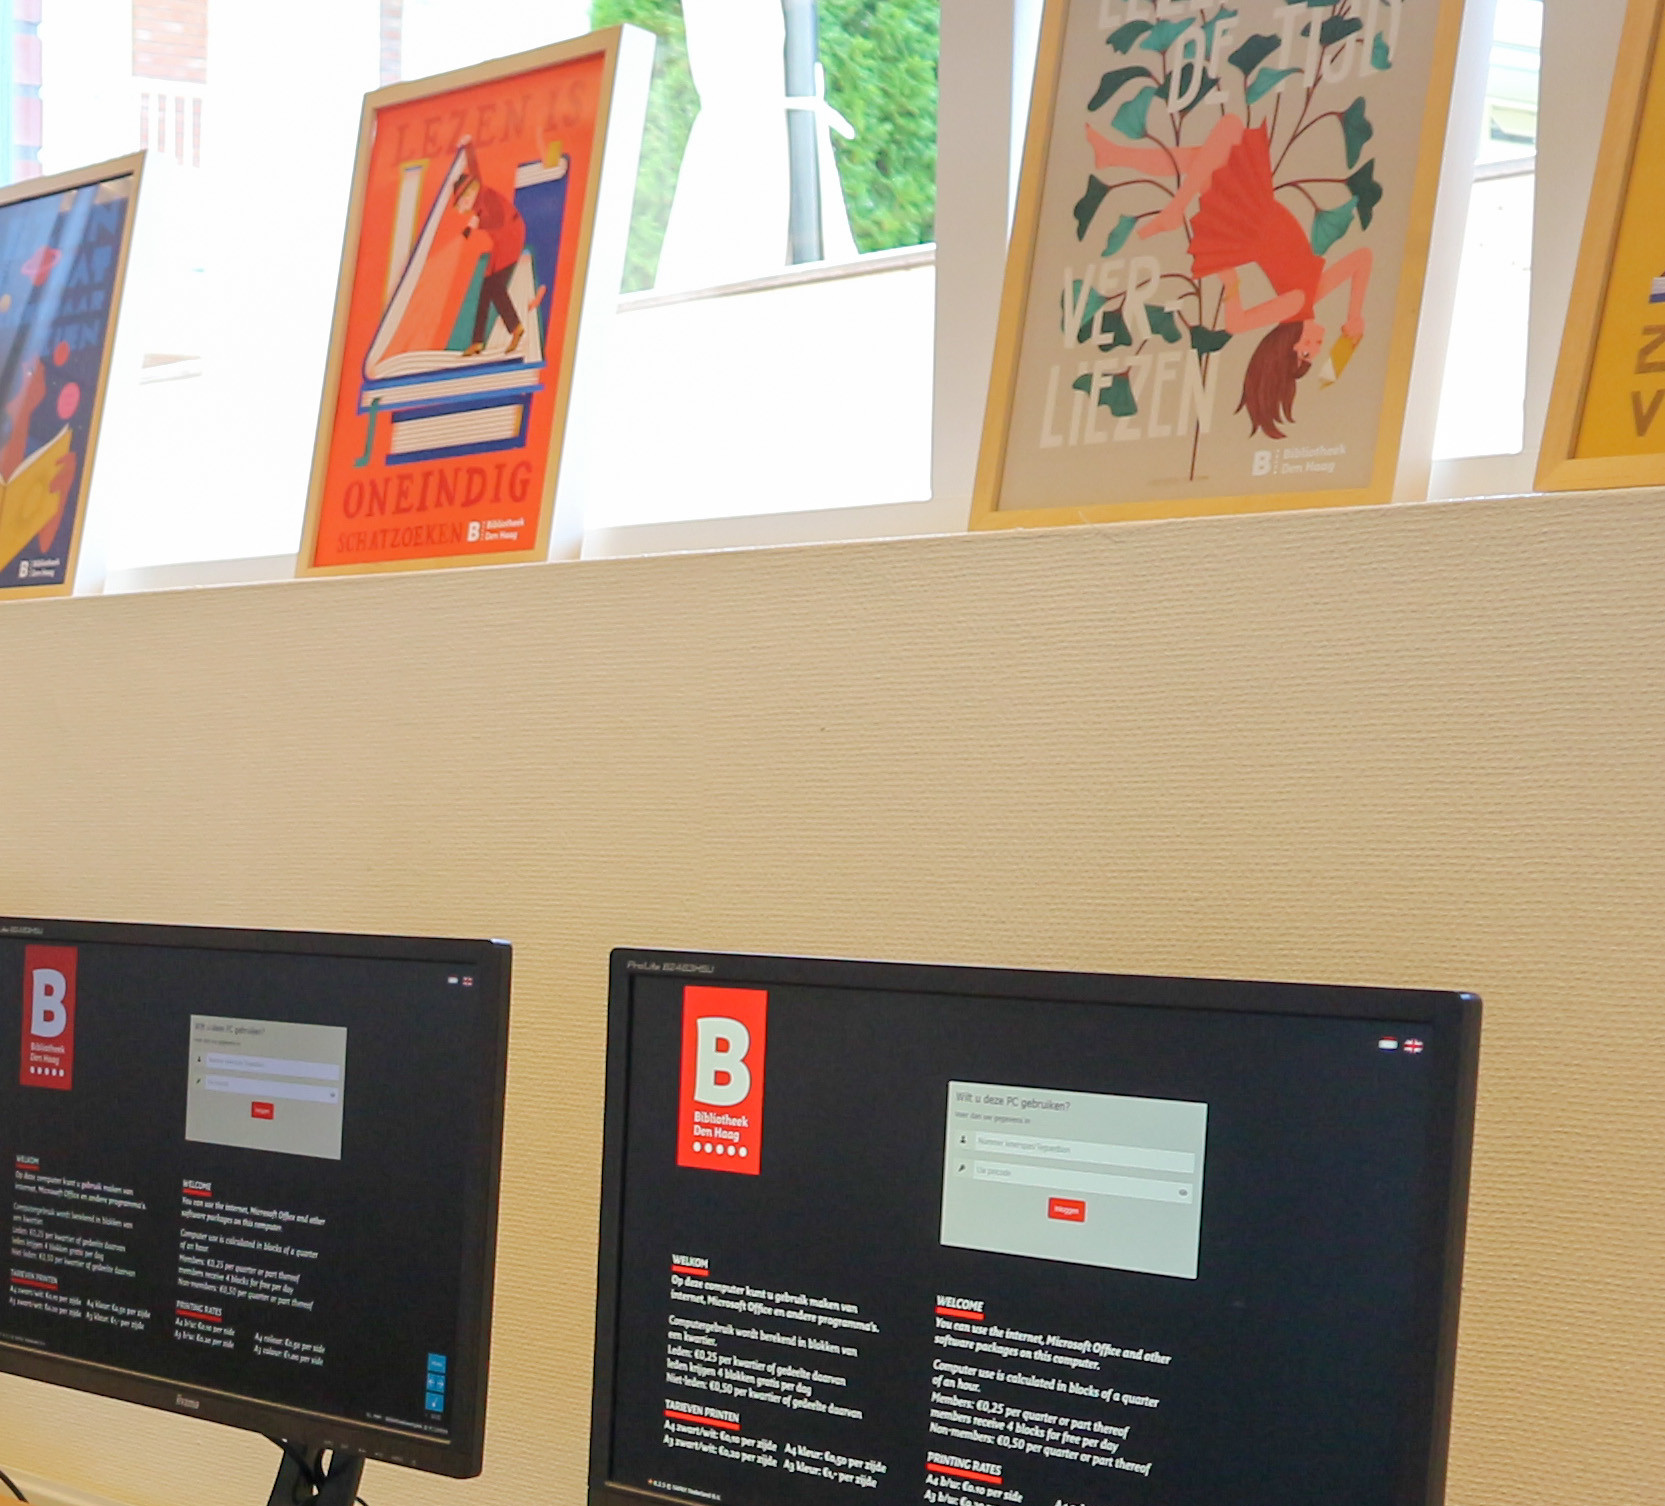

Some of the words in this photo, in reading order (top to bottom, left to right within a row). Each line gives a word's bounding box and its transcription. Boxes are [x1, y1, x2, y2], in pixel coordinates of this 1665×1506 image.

[395, 93, 529, 162] LEZEN
[543, 80, 585, 133] IS
[1039, 349, 1221, 449] LIEZEN
[1251, 450, 1274, 476] B
[1283, 444, 1346, 460] Bibliotheek
[1281, 462, 1303, 474] Den
[1305, 460, 1335, 474] Haag
[342, 460, 533, 519] ONEINDIG
[337, 522, 463, 554] SCHATZOEKEN
[467, 520, 481, 542] B
[30, 967, 67, 1038] B
[693, 1016, 752, 1107] B
[956, 1092, 973, 1104] Wilt
[975, 1095, 981, 1104] u
[983, 1094, 1005, 1106] deze
[1006, 1096, 1019, 1107] PC
[1021, 1098, 1071, 1112] gebruiken?
[693, 1124, 713, 1138] Den
[714, 1126, 740, 1142] Haag
[694, 1111, 749, 1128] Bibliotheek
[672, 1254, 709, 1269] WELKOM
[704, 1282, 745, 1295] computer
[745, 1285, 767, 1299] kunt
[766, 1291, 774, 1300] u
[809, 1297, 840, 1311] maken
[840, 1303, 858, 1314] van
[707, 1294, 747, 1313] Microsoft
[747, 1301, 773, 1316] Office
[773, 1308, 786, 1317] en
[785, 1309, 817, 1322] andere
[936, 1294, 984, 1312] WELCOME
[934, 1334, 975, 1350] software
[974, 1341, 1019, 1358] packages
[1019, 1349, 1033, 1359] on
[1033, 1349, 1052, 1362] this
[936, 1316, 953, 1330] You
[953, 1322, 971, 1333] can
[971, 1324, 988, 1336] use
[988, 1325, 1005, 1338] the
[1045, 1334, 1092, 1354] Microsoft
[1092, 1341, 1122, 1357] Office
[1122, 1348, 1144, 1360] and
[1142, 1349, 1172, 1365] other
[718, 1355, 732, 1366] per
[933, 1358, 978, 1376] Computer
[978, 1368, 996, 1380] use
[996, 1369, 1005, 1381] is
[1006, 1372, 1056, 1390] calculated
[1056, 1379, 1067, 1392] in
[1068, 1381, 1100, 1398] blocks
[1111, 1388, 1121, 1402] a
[1121, 1394, 1160, 1408] quarter
[942, 1374, 956, 1388] an
[664, 1398, 703, 1416] TARIEVEN
[704, 1406, 740, 1423] PRINTEN
[1004, 1407, 1022, 1418] per
[1022, 1410, 1059, 1424] quarter
[1058, 1417, 1070, 1426] or
[1070, 1419, 1092, 1431] part
[1093, 1420, 1131, 1440] thereof
[930, 1408, 972, 1424] members
[972, 1416, 1006, 1431] receive
[1006, 1420, 1014, 1432] 4
[1014, 1421, 1045, 1438] blocks
[1045, 1427, 1061, 1442] for
[1061, 1430, 1081, 1445] free
[1081, 1437, 1100, 1448] per
[1099, 1438, 1119, 1454] day
[926, 1451, 972, 1470] PRINTING
[971, 1460, 1002, 1476] RATES
[1025, 1442, 1043, 1454] per
[1042, 1446, 1080, 1460] quarter
[1079, 1453, 1092, 1462] or
[1091, 1455, 1114, 1467] part
[1114, 1457, 1152, 1476] thereof
[986, 1488, 1003, 1498] per
[1003, 1489, 1023, 1503] side
